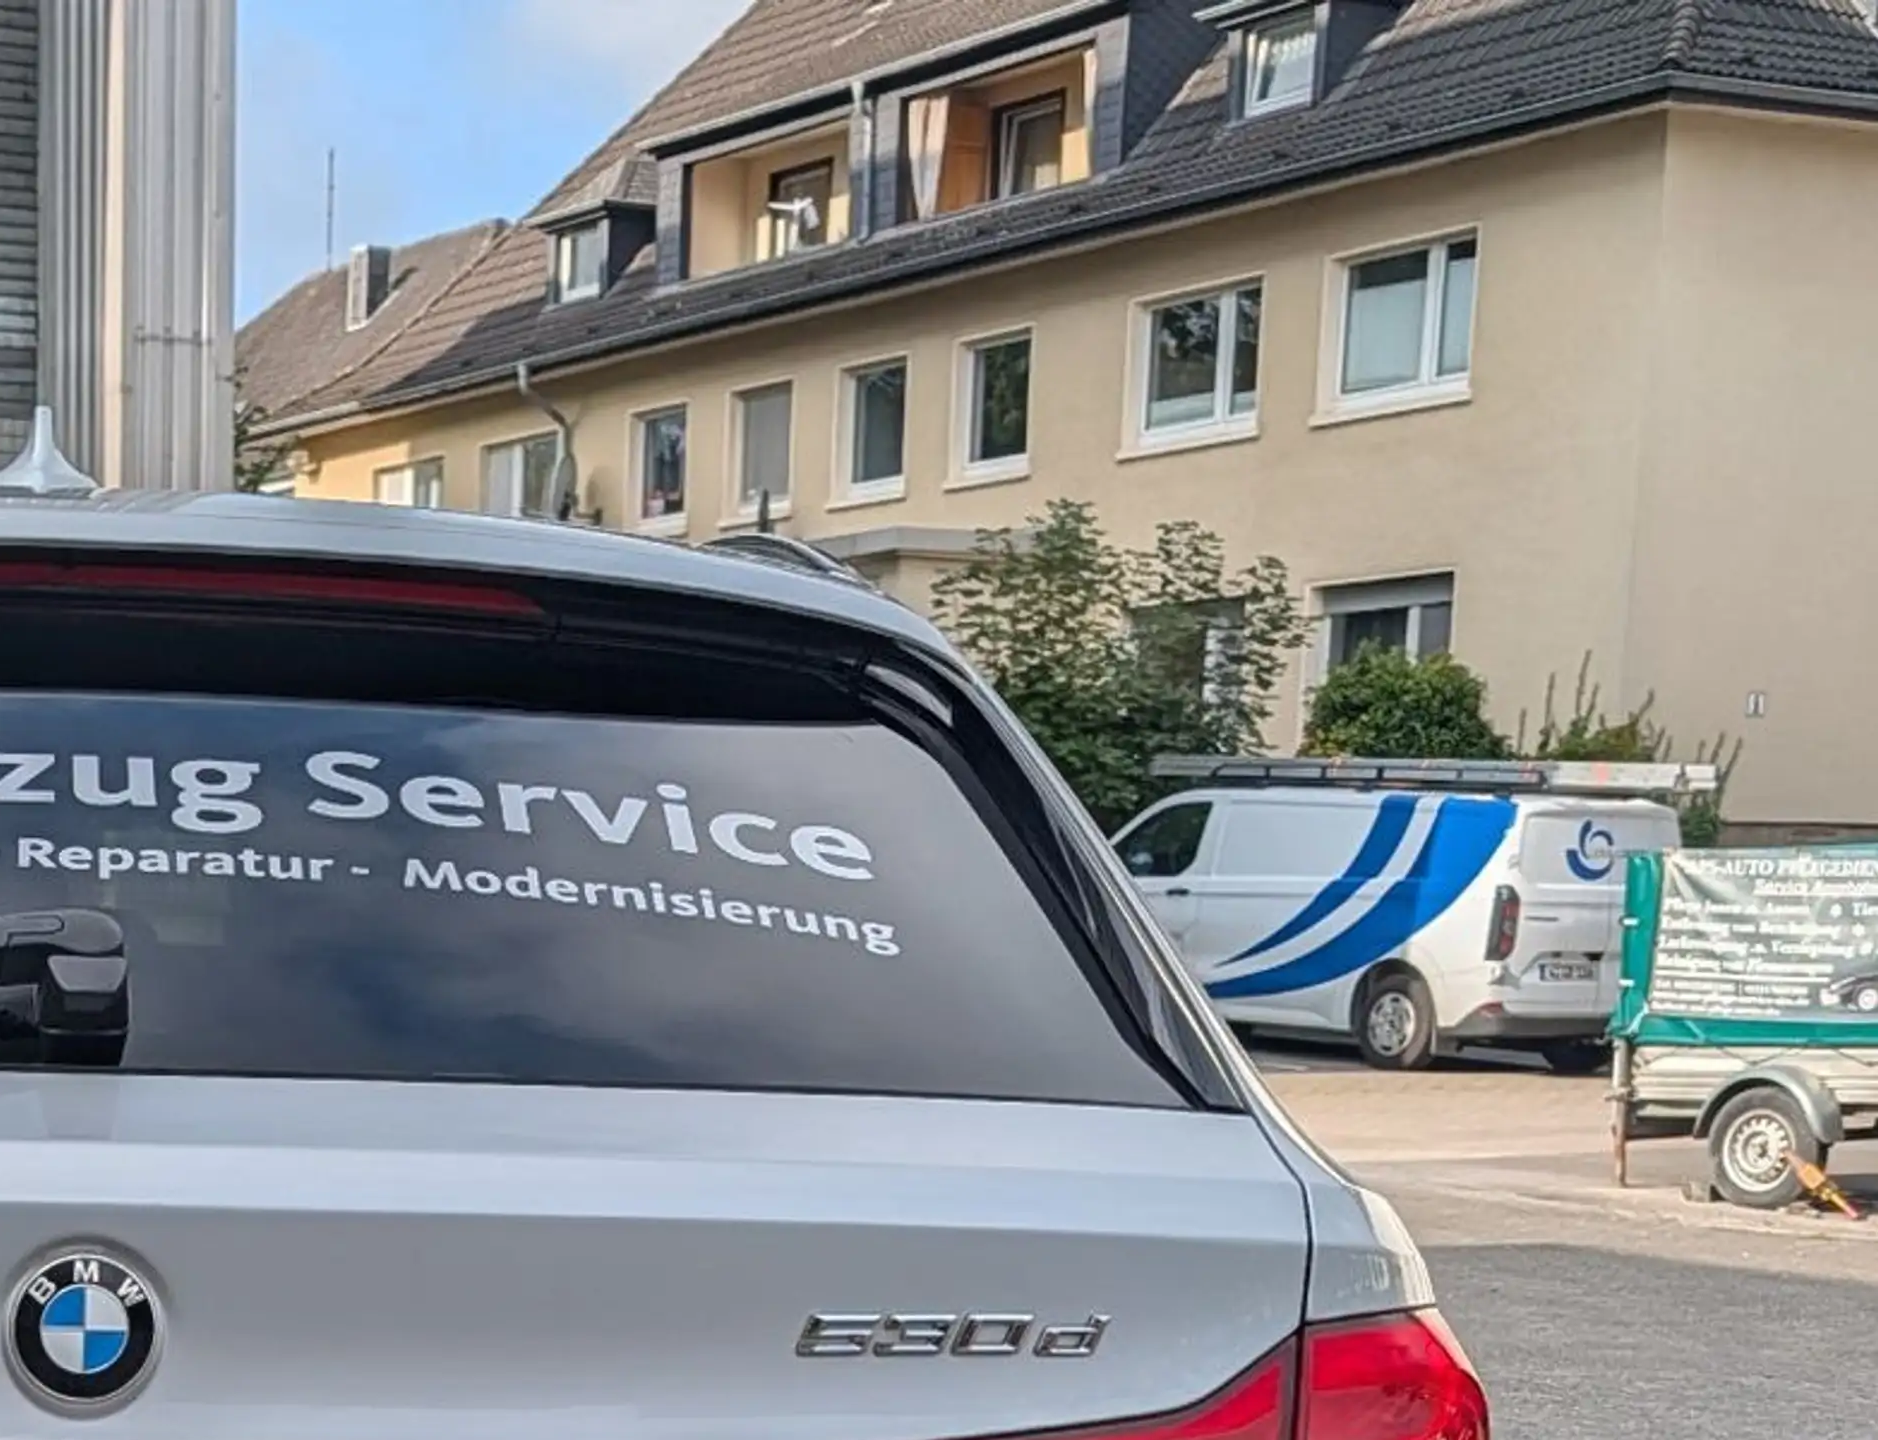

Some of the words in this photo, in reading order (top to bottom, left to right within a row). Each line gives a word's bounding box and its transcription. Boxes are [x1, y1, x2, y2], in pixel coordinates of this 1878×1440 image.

[306, 750, 876, 880] Service
[17, 837, 335, 882] Reparatur
[403, 857, 901, 957] Modernisierung
[28, 1259, 144, 1307] BMW
[794, 1310, 1113, 1358] 530d
